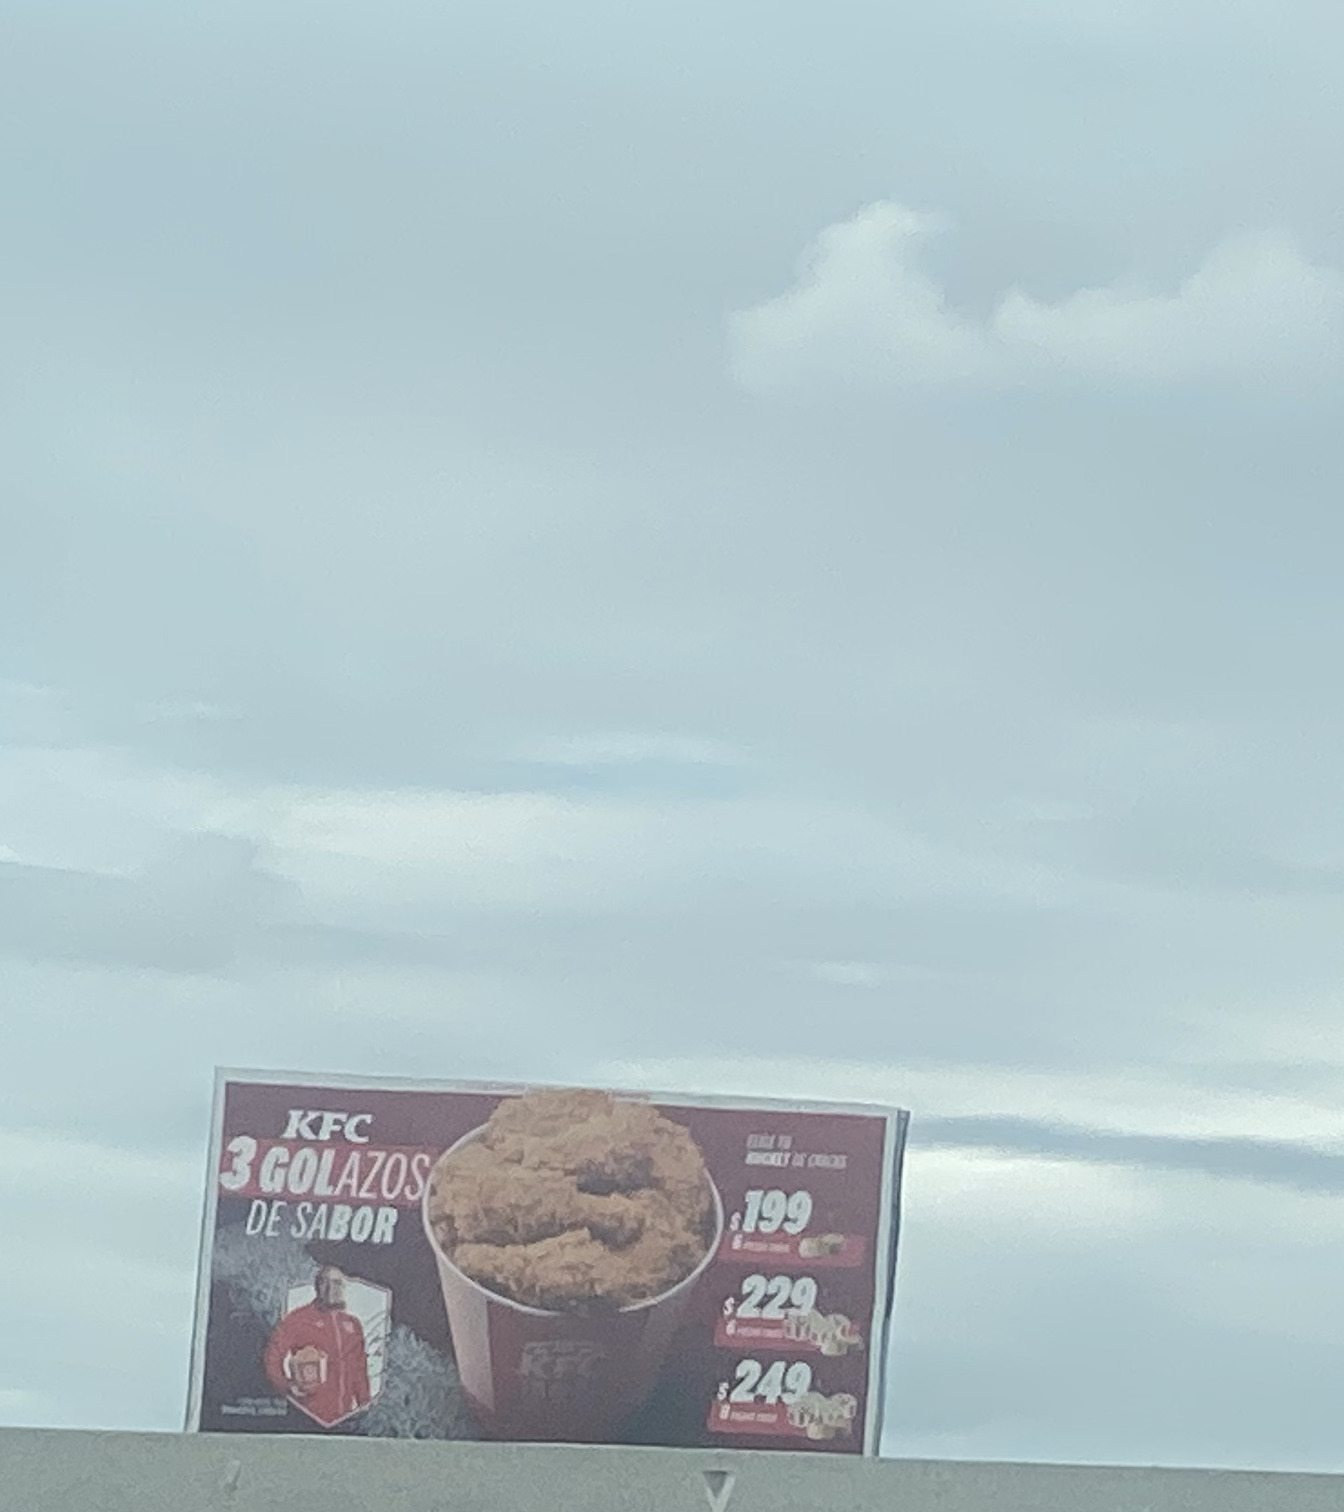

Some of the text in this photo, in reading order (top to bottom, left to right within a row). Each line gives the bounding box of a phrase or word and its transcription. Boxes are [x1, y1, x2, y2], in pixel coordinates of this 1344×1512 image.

[280, 1109, 374, 1143] KFC
[219, 1136, 431, 1201] 3 GOLAZOS
[246, 1199, 399, 1244] DE SABOR
[730, 1189, 813, 1235] $199
[722, 1274, 818, 1319] $229
[717, 1359, 813, 1405] $249
